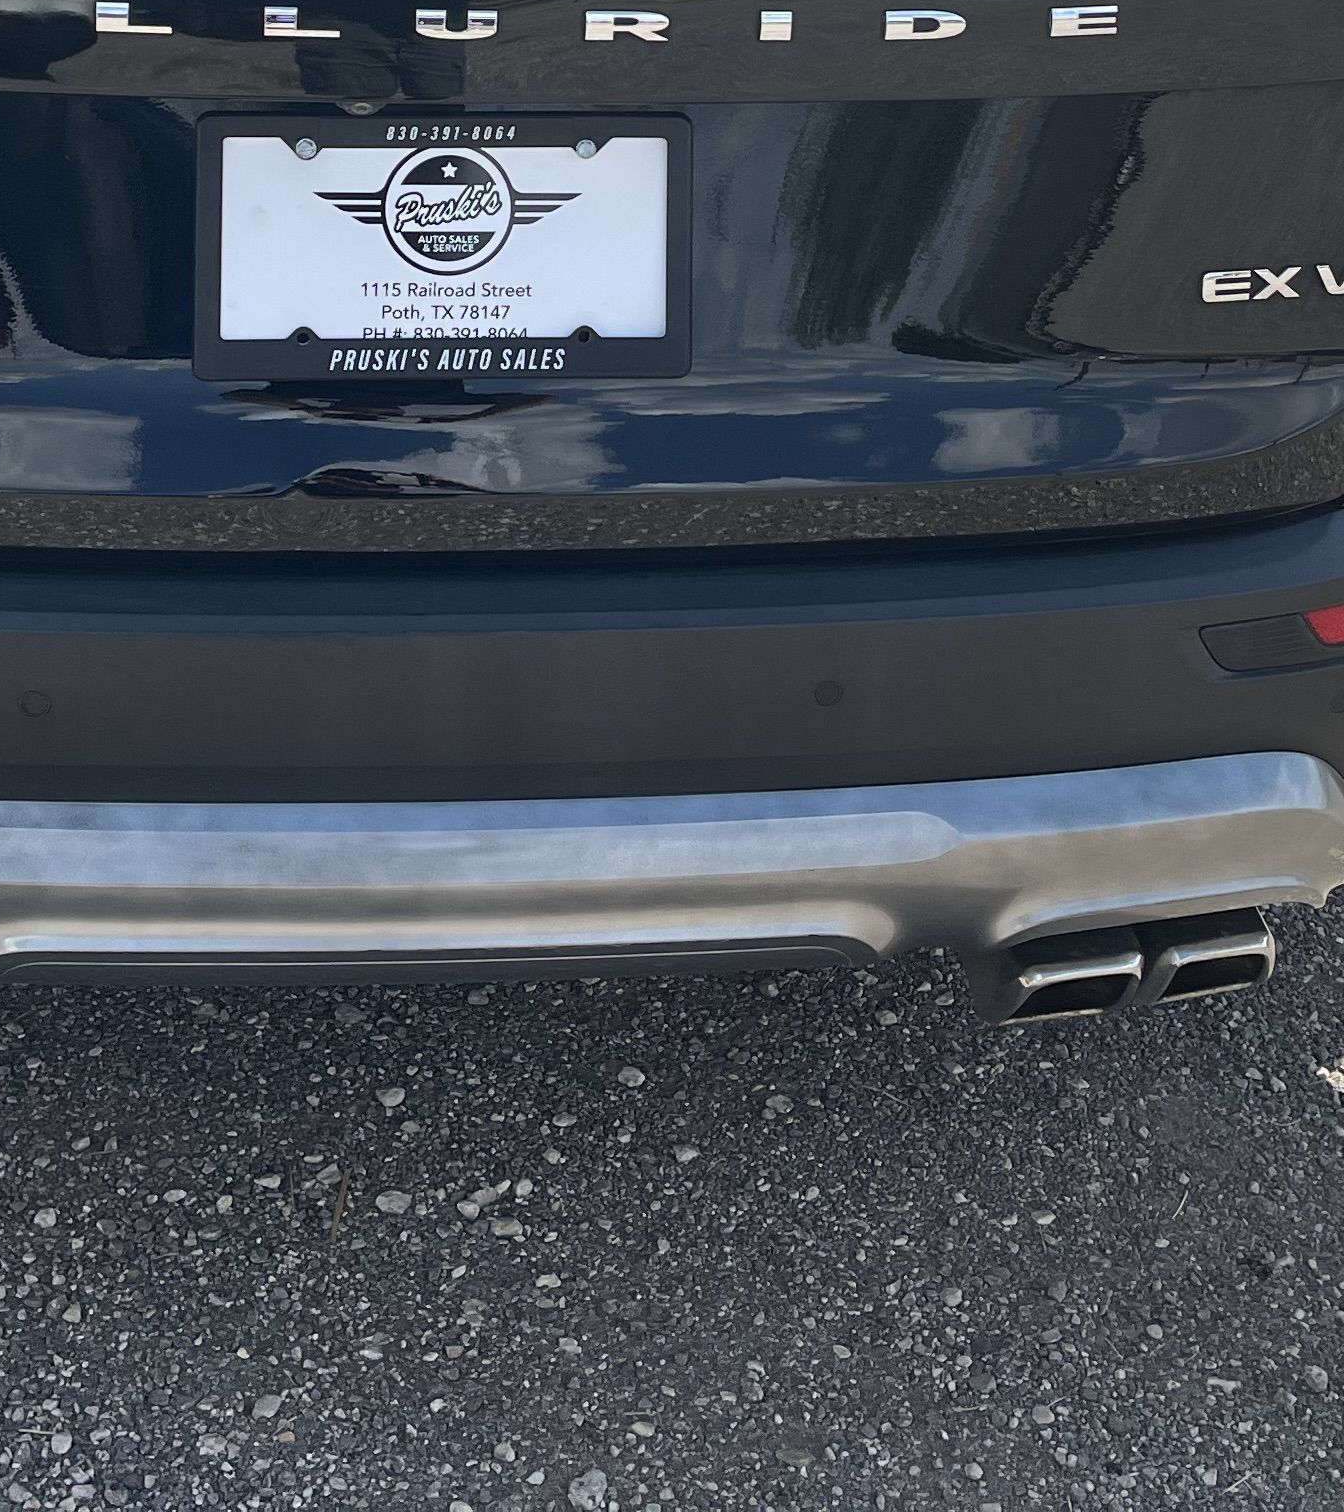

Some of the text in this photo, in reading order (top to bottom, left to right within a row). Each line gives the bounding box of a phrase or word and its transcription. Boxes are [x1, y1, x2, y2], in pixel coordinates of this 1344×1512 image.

[386, 125, 516, 141] 830-391-8064
[395, 182, 503, 233] Pruski's
[417, 234, 480, 244] AUTO SALES
[422, 243, 475, 253] & SERVICE
[361, 281, 533, 298] 1115 Railroad Street
[1202, 266, 1302, 303] EX
[381, 304, 511, 321] Poth, TX 78147
[362, 327, 387, 338] PH
[413, 327, 529, 338] 830-391-8064
[329, 348, 567, 371] PRUSKI'S AUTO SALES
